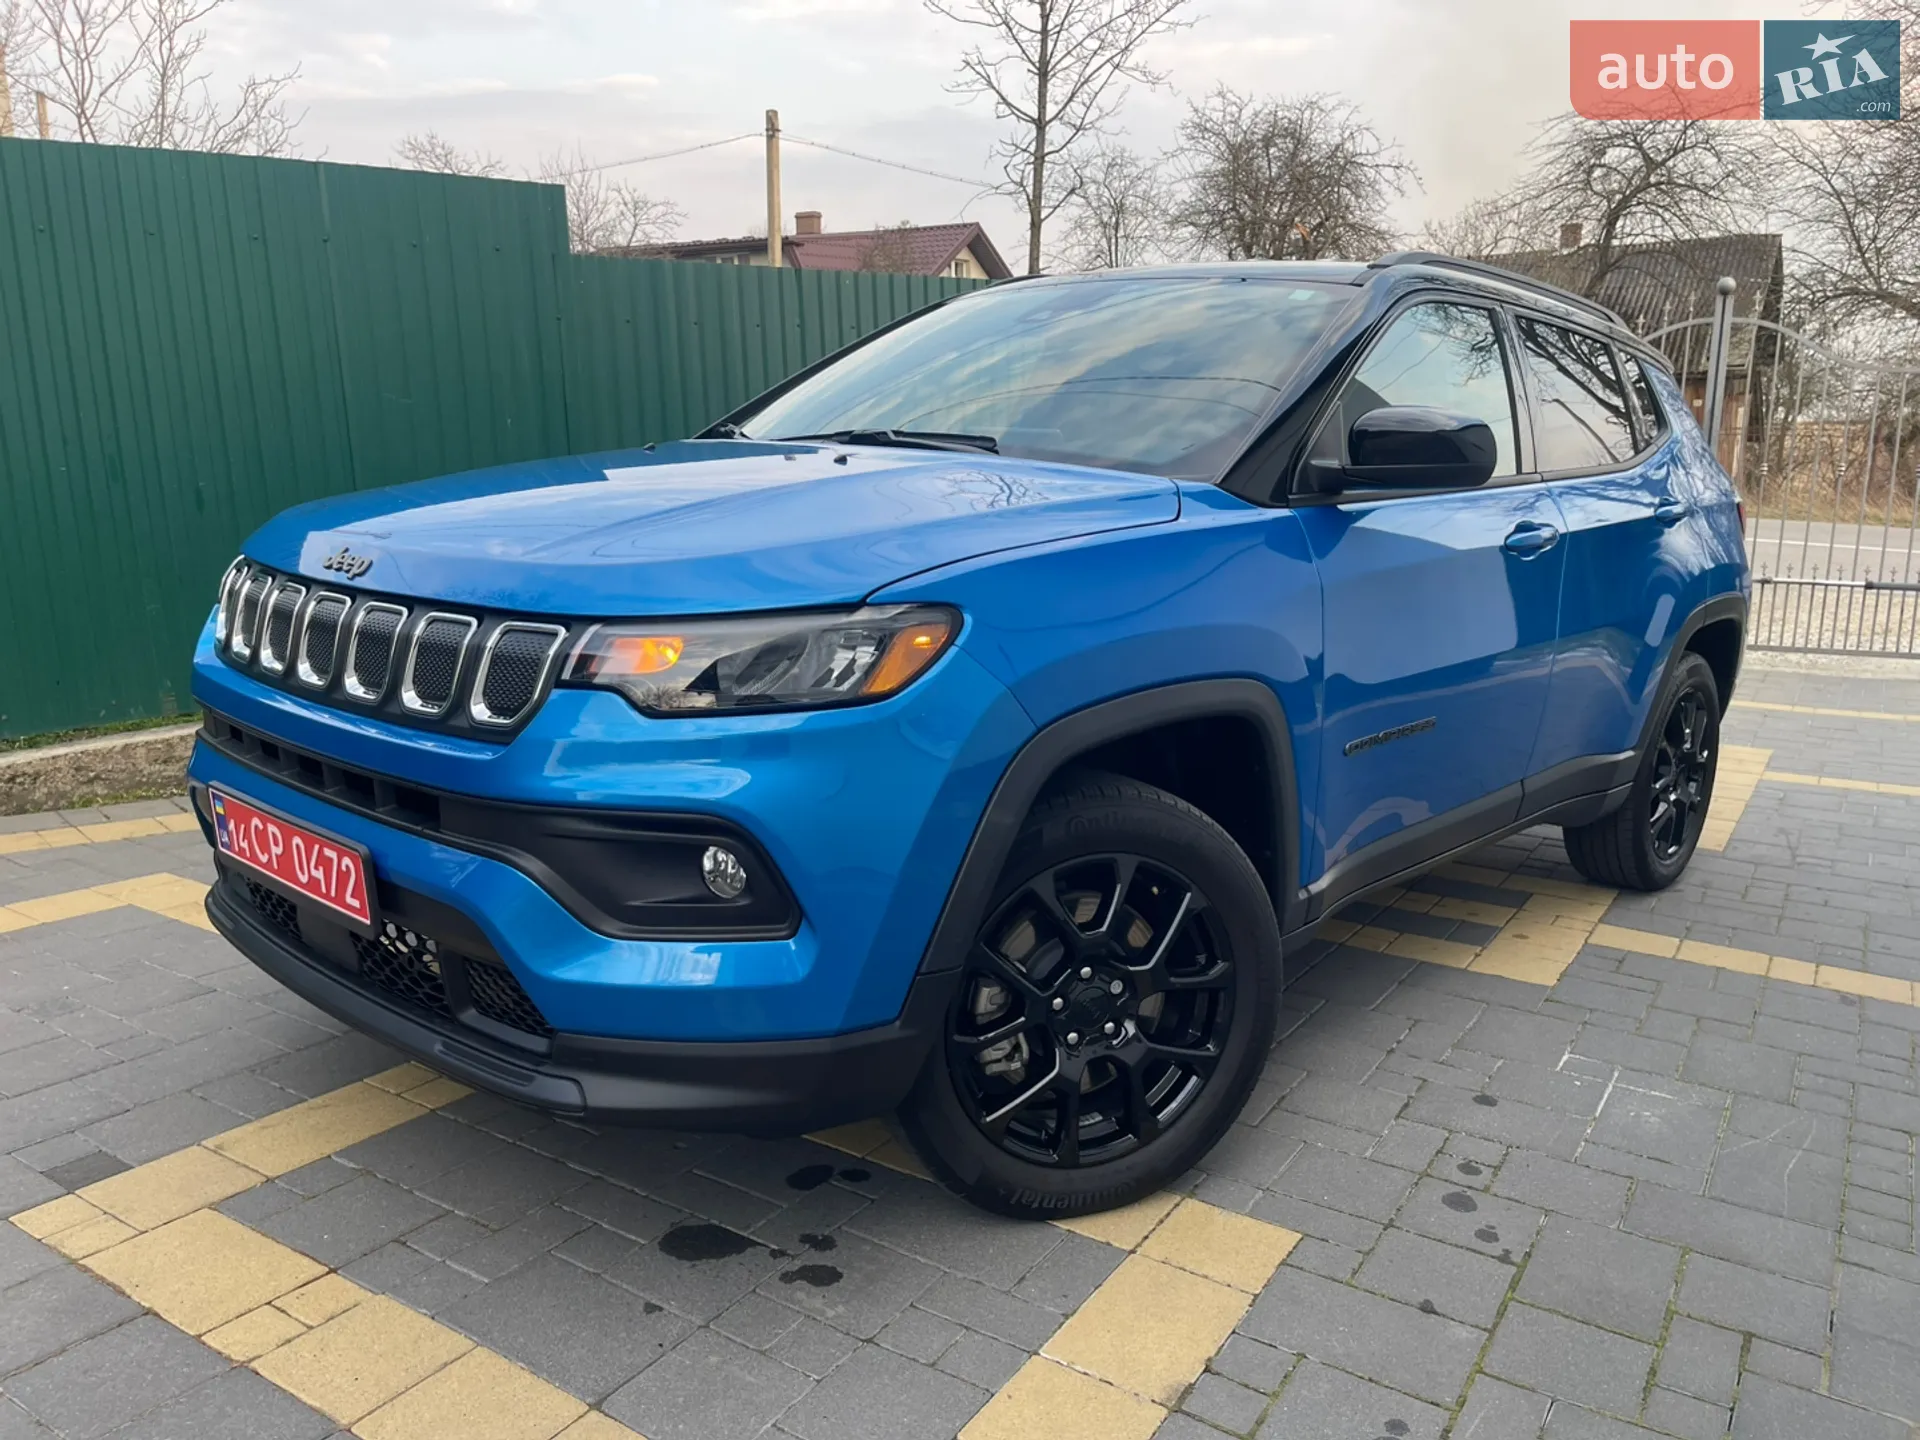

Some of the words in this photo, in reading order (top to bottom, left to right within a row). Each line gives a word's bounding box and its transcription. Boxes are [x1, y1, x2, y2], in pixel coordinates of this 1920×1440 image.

[323, 547, 373, 581] Jeep
[228, 816, 284, 870] 14CP
[291, 836, 361, 908] 0472
